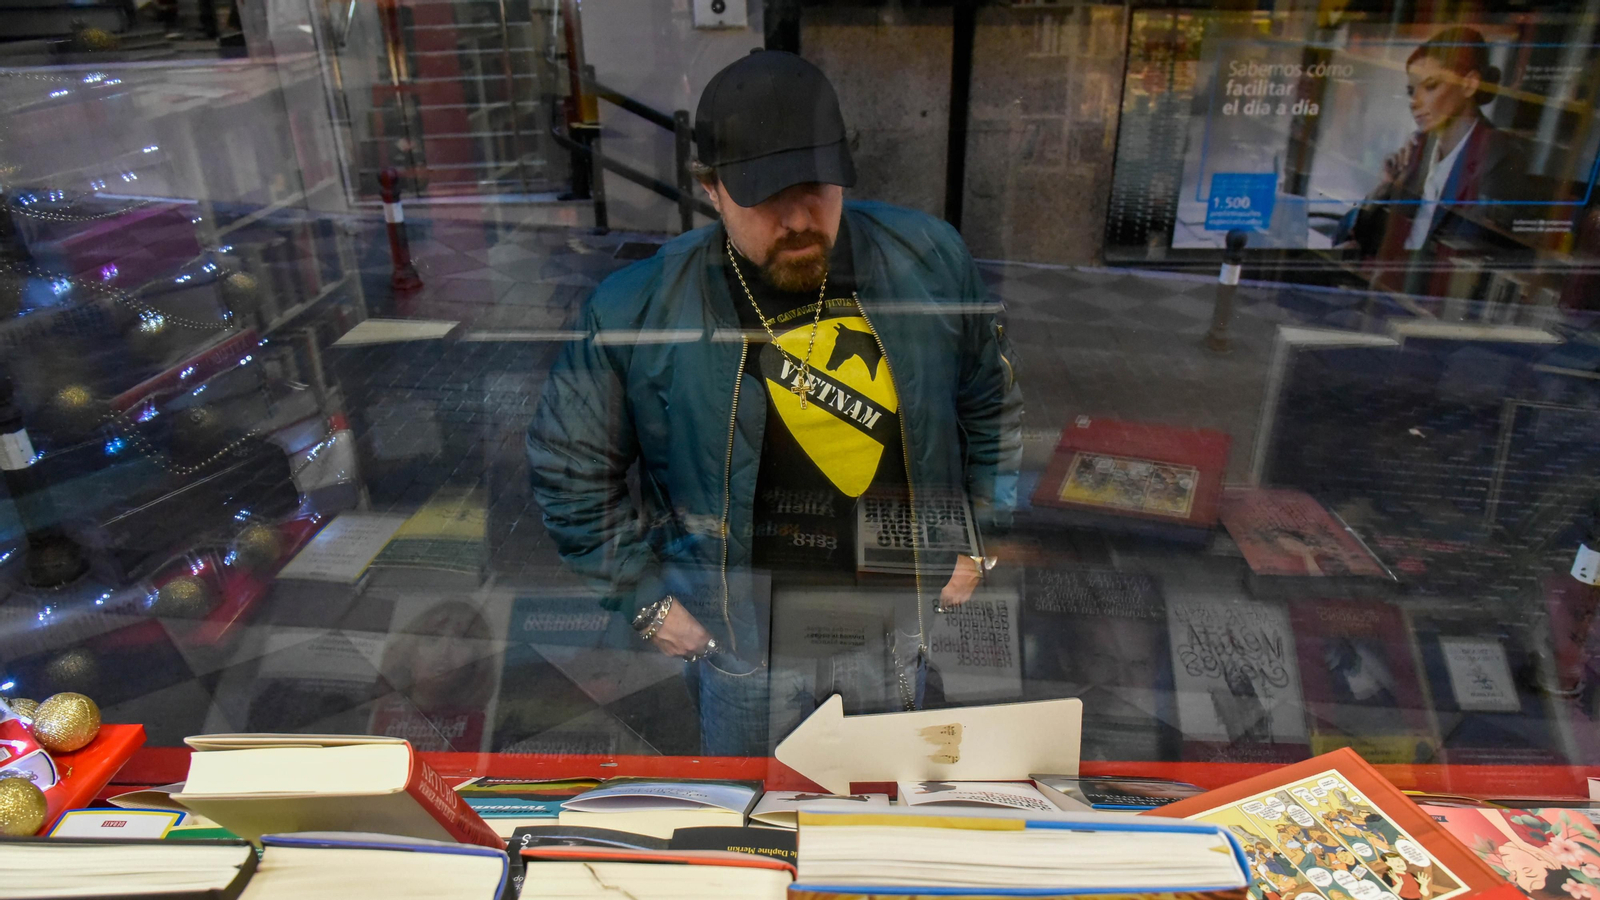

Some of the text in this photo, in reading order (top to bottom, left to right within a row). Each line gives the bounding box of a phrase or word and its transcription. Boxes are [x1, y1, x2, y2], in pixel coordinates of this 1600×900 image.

[1228, 60, 1354, 78] Sabemos cómo
[1225, 78, 1295, 97] facilitar
[1222, 99, 1240, 116] el
[1276, 103, 1287, 116] a
[1291, 99, 1319, 116] día
[1213, 196, 1251, 209] 1.500
[780, 358, 883, 430] VIETNAM
[421, 761, 458, 809] ARTURO
[727, 846, 756, 856] Merkin
[758, 847, 789, 859] Daphne
